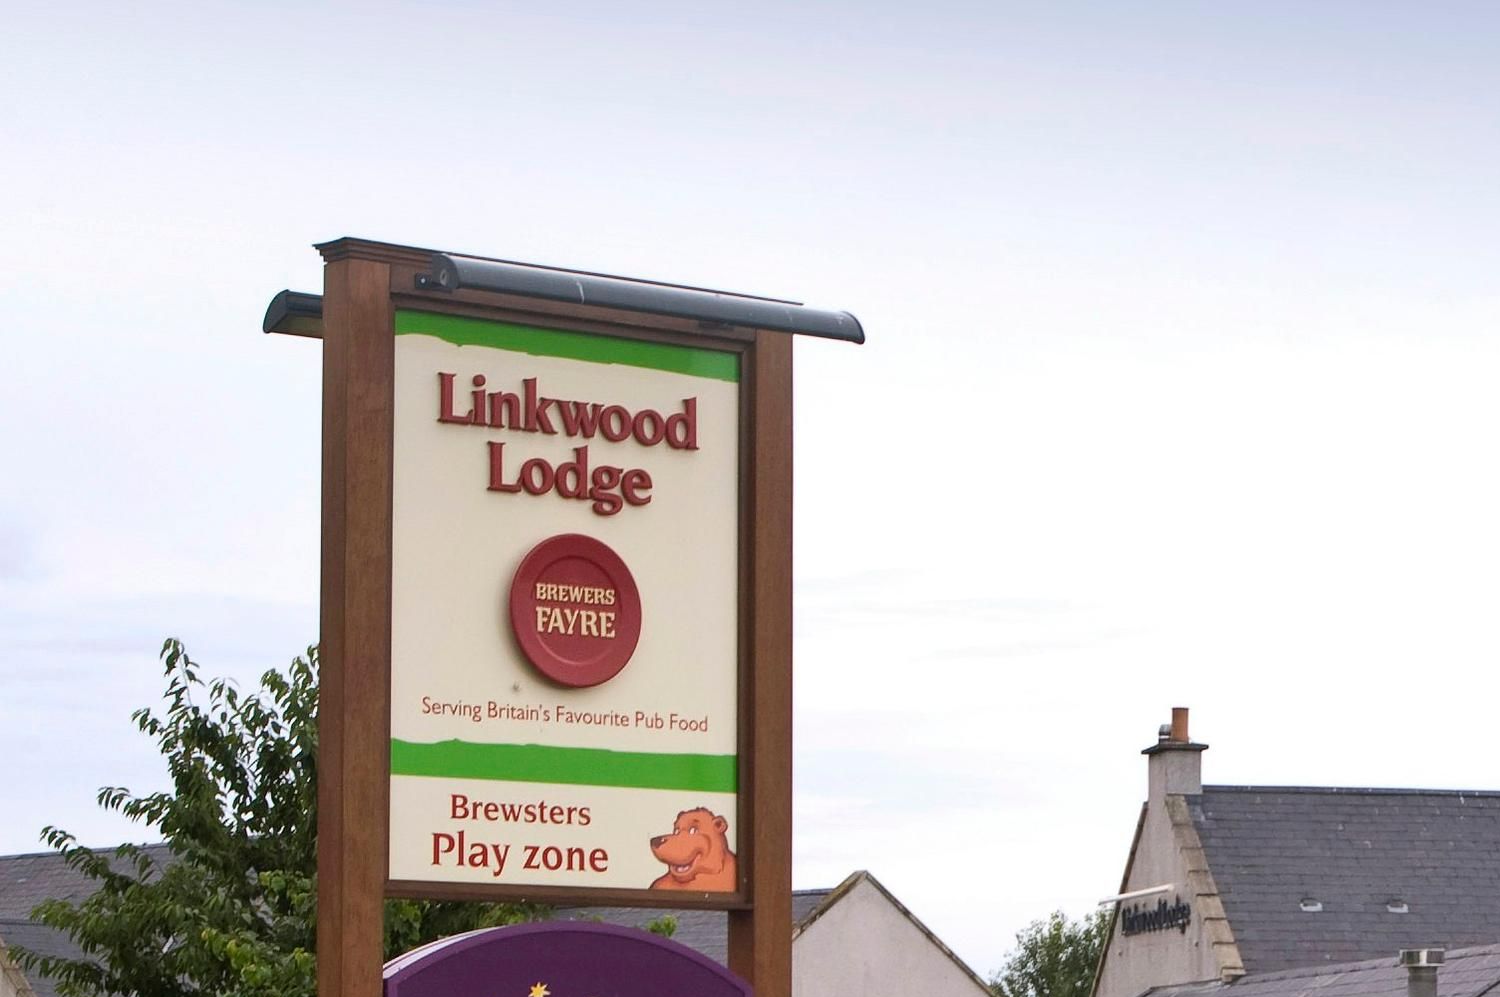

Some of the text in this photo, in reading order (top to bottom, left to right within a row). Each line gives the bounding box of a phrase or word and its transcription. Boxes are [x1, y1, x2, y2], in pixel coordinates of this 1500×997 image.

[437, 371, 700, 451] Linkwood
[486, 440, 653, 516] Lodge
[535, 582, 616, 606] BREWERS
[535, 606, 616, 639] FAYRE
[422, 696, 709, 732] Serving Britain's Favourite Pub Food
[450, 794, 591, 826] Brewsters
[431, 829, 609, 877] Play zone
